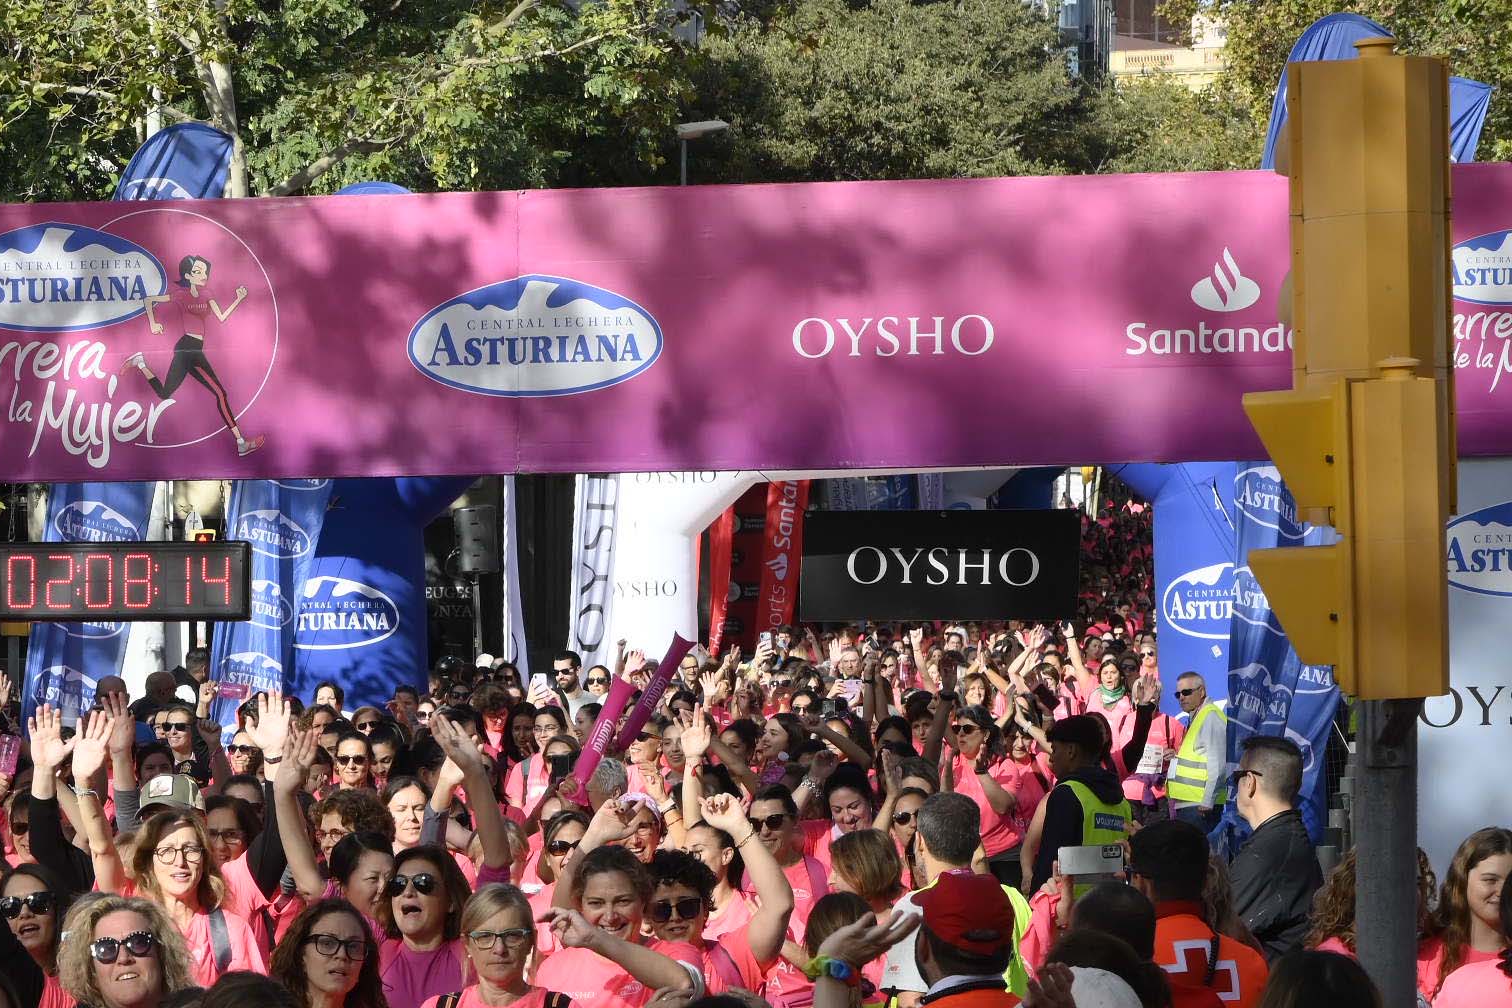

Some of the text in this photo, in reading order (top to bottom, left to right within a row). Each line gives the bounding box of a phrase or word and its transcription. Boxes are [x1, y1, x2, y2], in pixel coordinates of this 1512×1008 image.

[69, 258, 142, 270] LECHERA
[427, 322, 643, 367] ASTURIANA
[466, 315, 636, 331] CENTRAL LECHERA
[791, 313, 995, 359] OYSHO
[8, 383, 33, 424] la
[27, 374, 177, 469] Mujer
[846, 545, 1040, 588] OYSHO
